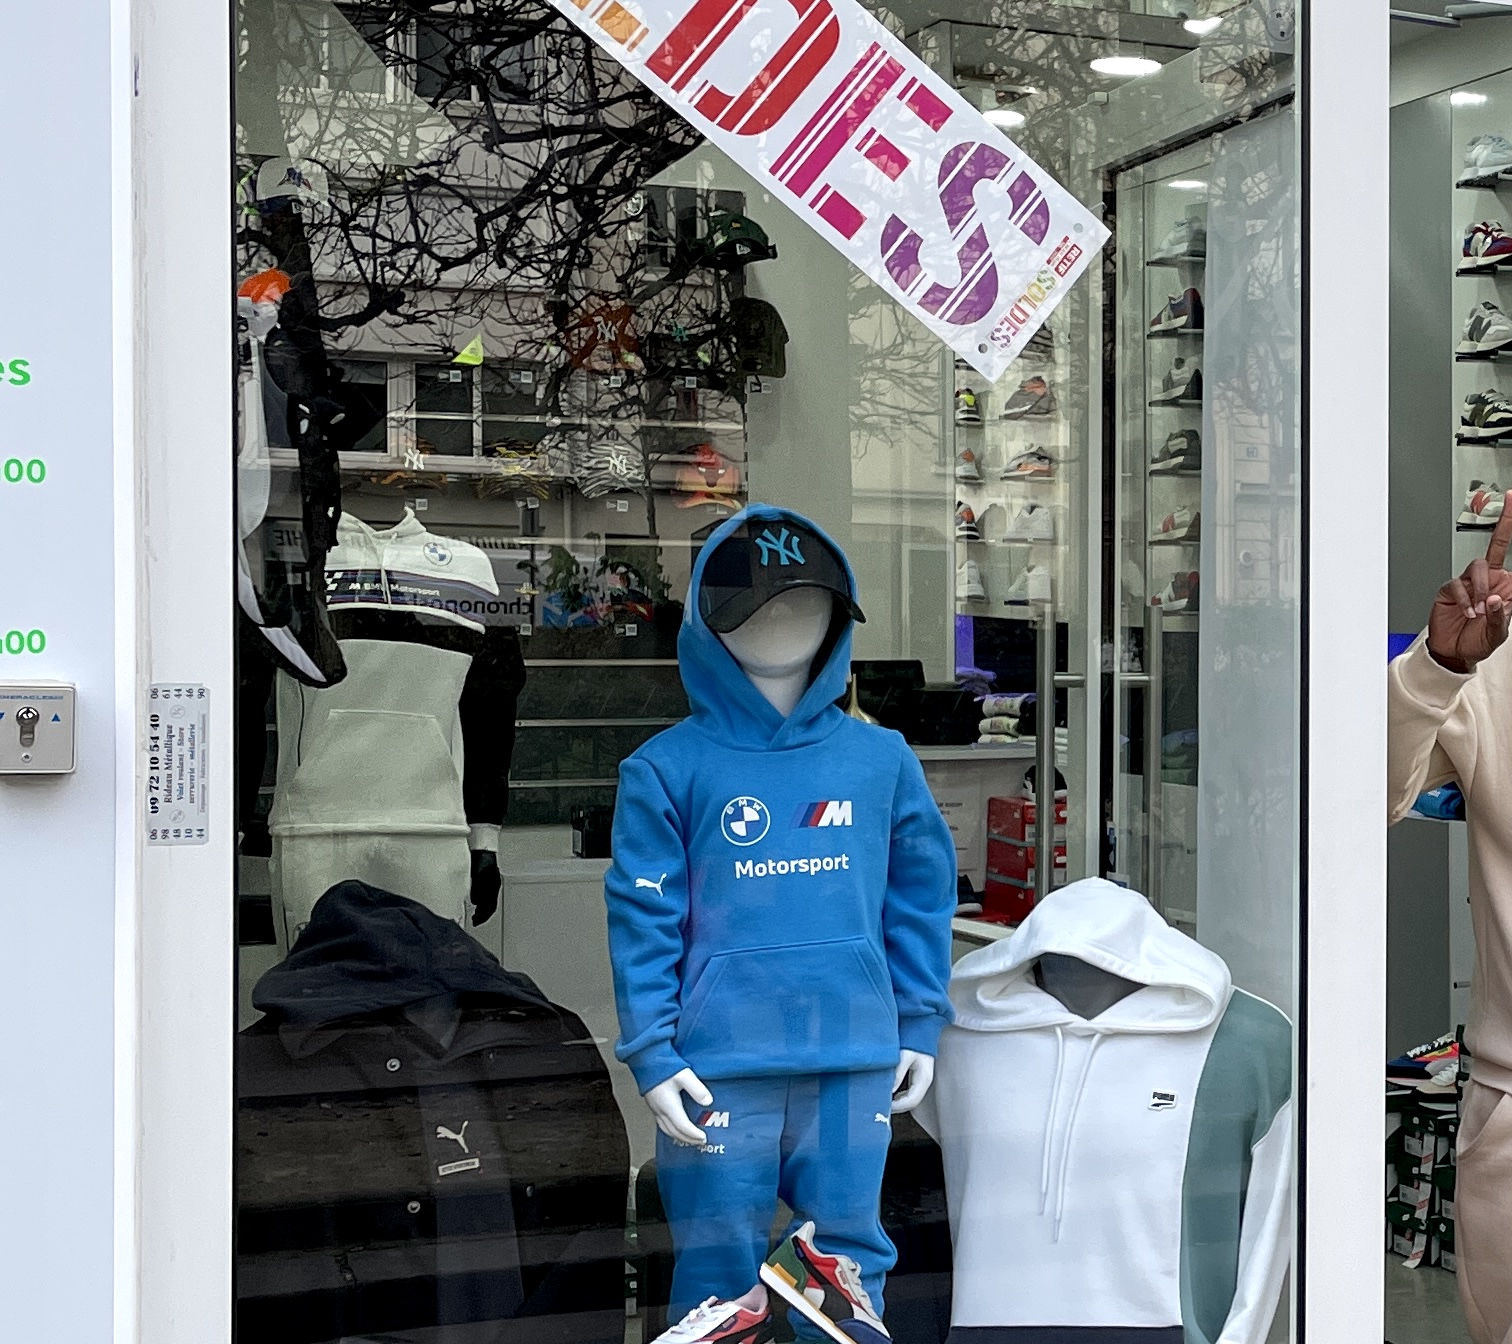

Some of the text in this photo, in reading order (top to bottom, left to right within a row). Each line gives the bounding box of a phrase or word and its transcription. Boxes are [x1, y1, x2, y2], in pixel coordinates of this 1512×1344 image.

[990, 269, 1057, 348] SOLDES
[0, 459, 46, 484] 00
[149, 714, 160, 731] 40
[149, 736, 160, 752] 54
[149, 756, 160, 771] 10
[163, 724, 175, 803] Rideau Métallique
[149, 775, 160, 793] 72
[735, 853, 850, 879] Motorsport
